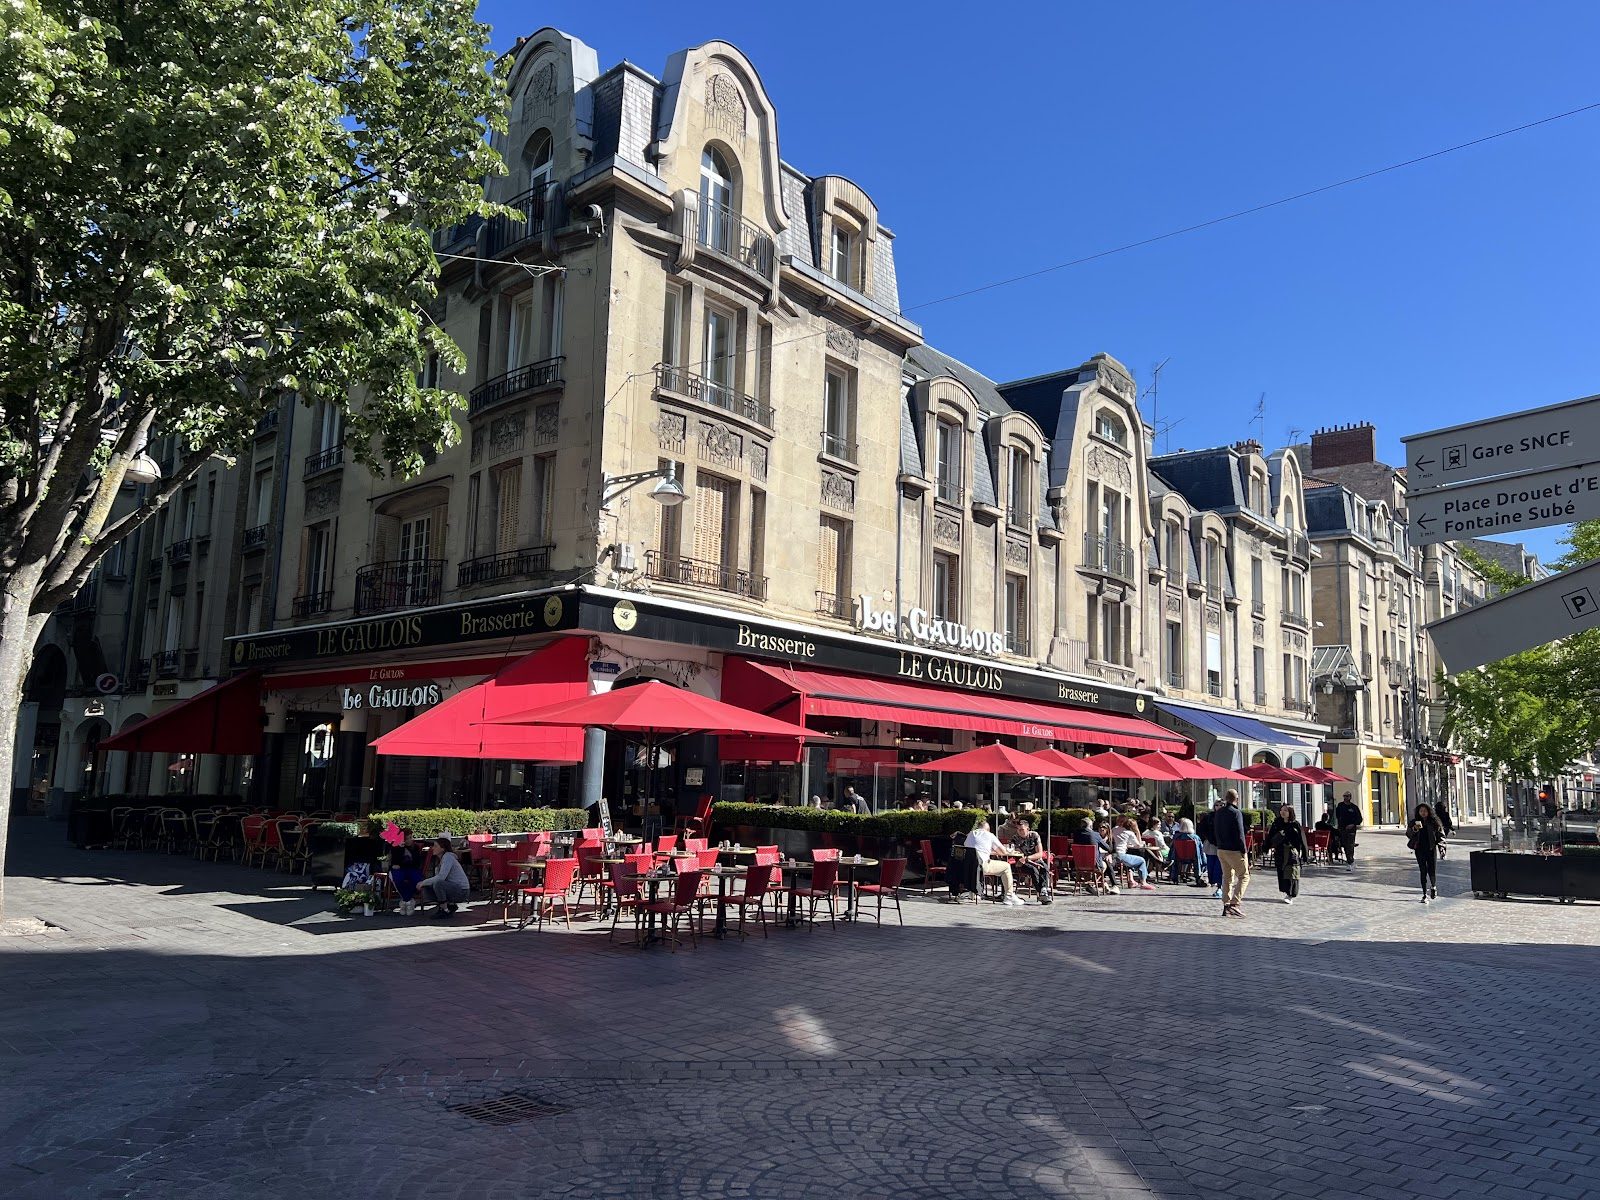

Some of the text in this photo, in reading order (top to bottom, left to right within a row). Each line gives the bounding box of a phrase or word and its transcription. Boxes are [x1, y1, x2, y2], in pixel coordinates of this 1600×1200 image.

[1472, 430, 1571, 460] Gare SNCF
[1444, 498, 1490, 514] Place
[1496, 483, 1562, 507] Drouet
[1444, 500, 1576, 533] Fontaine Subé
[1571, 595, 1586, 613] P
[316, 615, 423, 655] LE GAULOIS
[461, 604, 535, 636] Brasserie
[861, 594, 1003, 654] Le GAULOIS
[248, 639, 291, 661] Brasserie
[736, 623, 816, 657] Brasserie
[898, 650, 1003, 691] LE GAULOIS
[343, 684, 439, 710] Le GAULOIS
[1057, 682, 1099, 704] Brasserie
